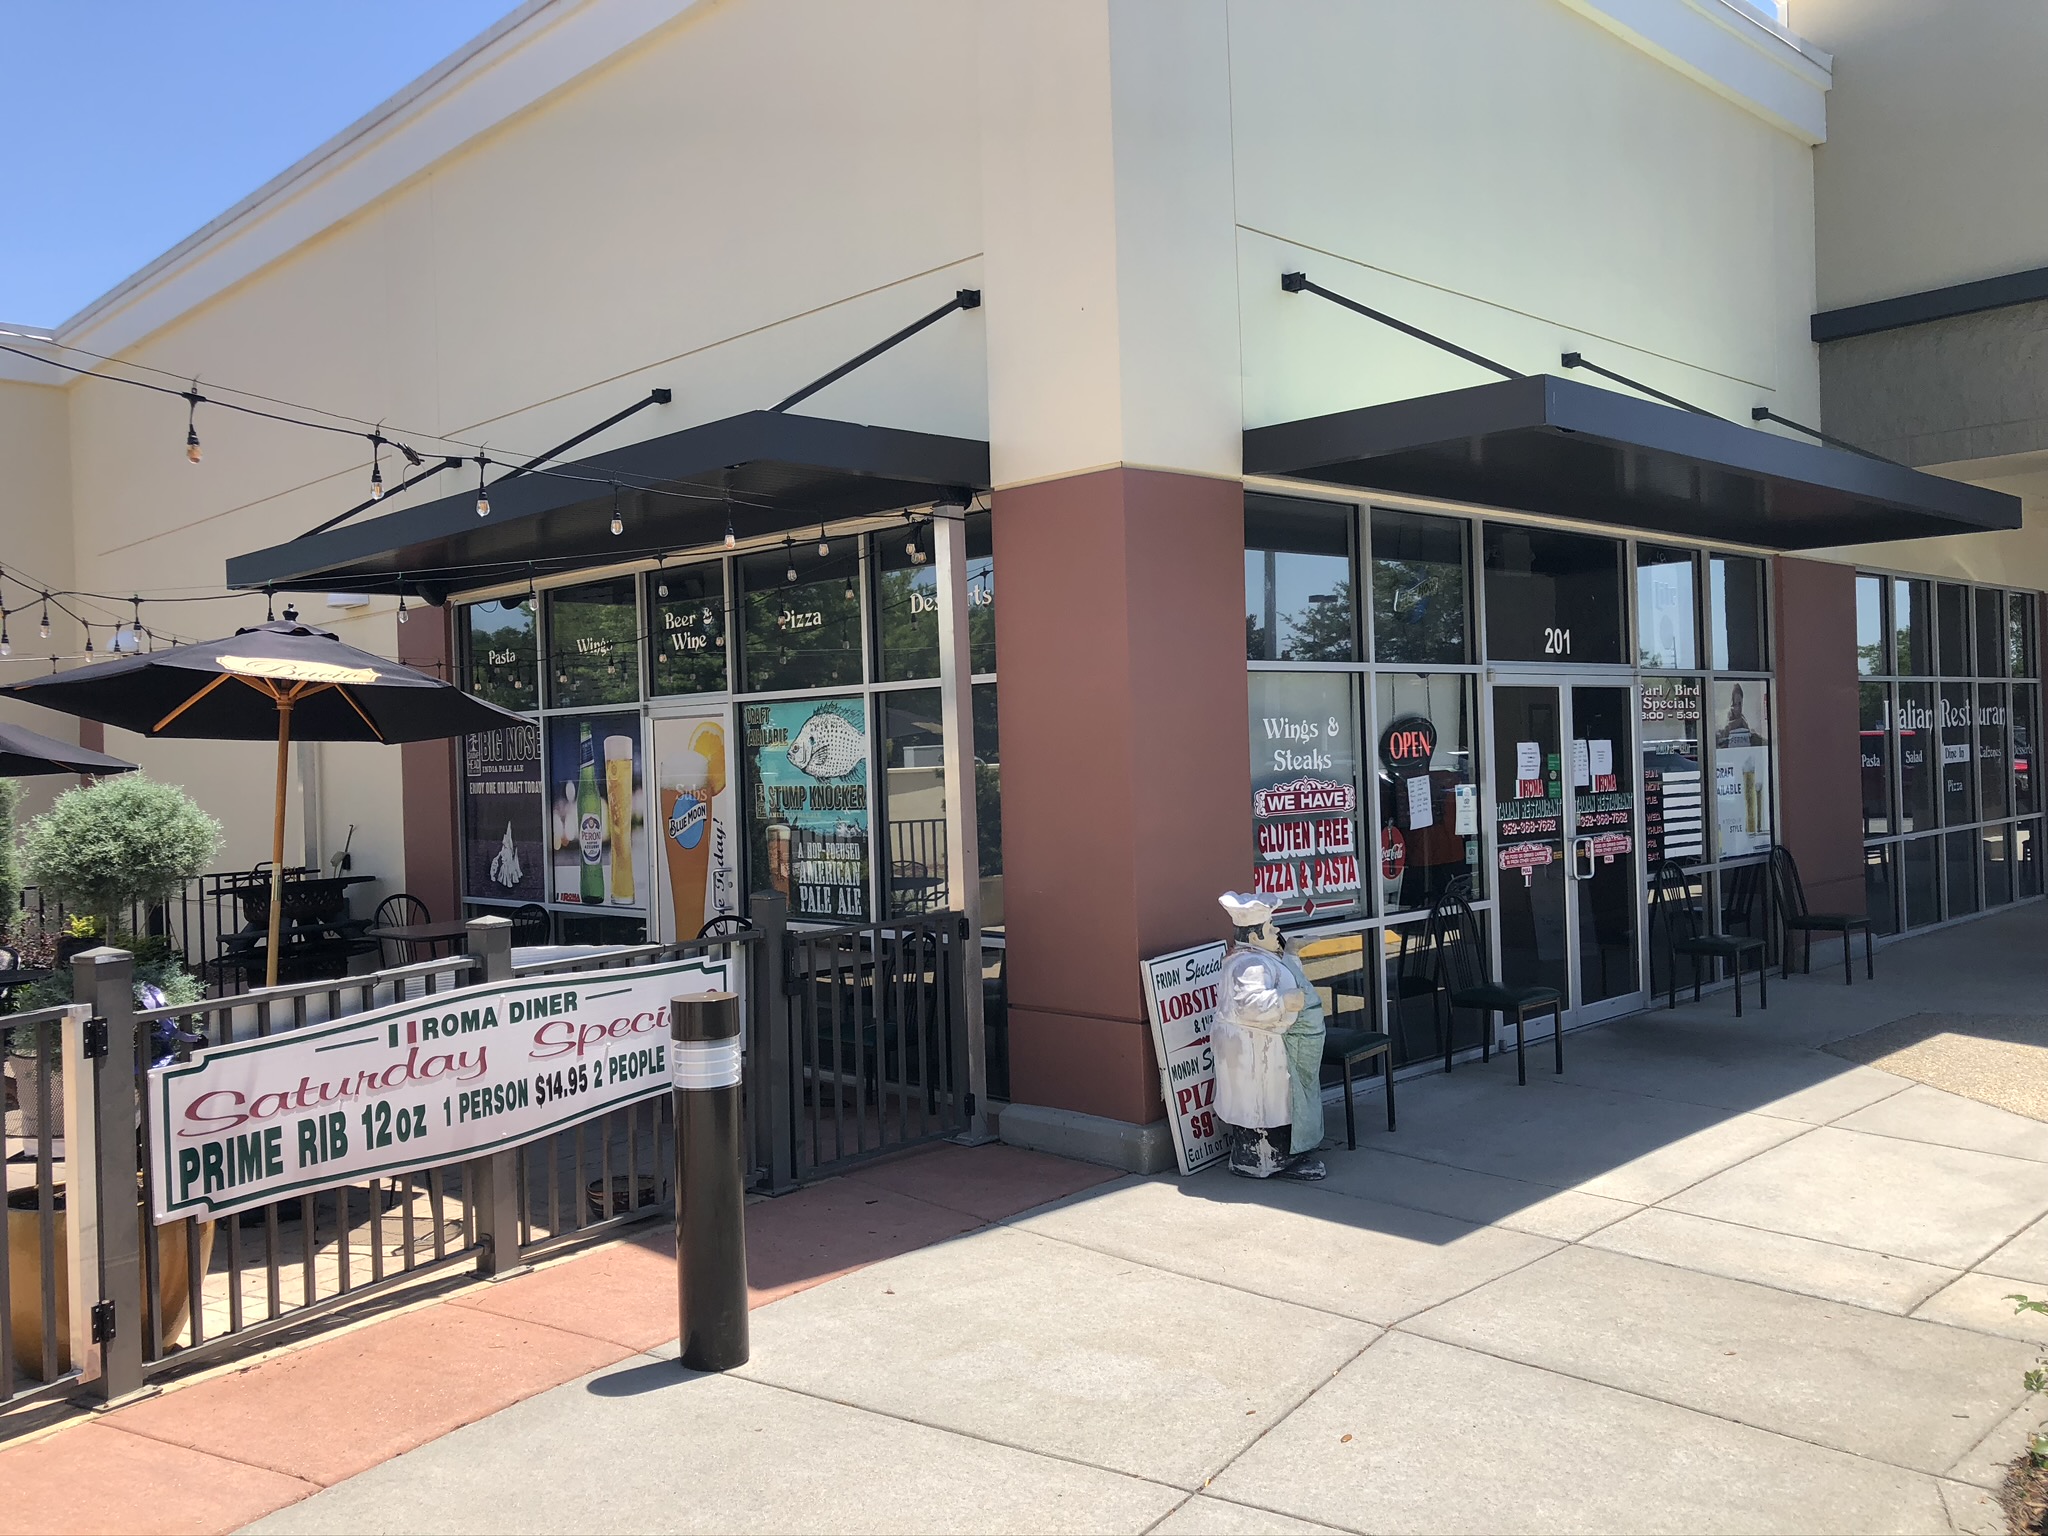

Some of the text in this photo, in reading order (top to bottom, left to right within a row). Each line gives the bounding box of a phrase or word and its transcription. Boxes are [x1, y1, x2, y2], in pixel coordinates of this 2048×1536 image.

[910, 584, 992, 614] Desrts
[665, 607, 713, 630] Beer &
[781, 610, 822, 630] Pizza
[577, 638, 613, 656] Wings
[671, 633, 707, 651] Wine
[1545, 627, 1571, 655] 201
[488, 648, 516, 665] Pasta
[1674, 684, 1700, 696] Bird
[746, 706, 771, 725] DRAFT
[1643, 697, 1696, 711] Specials
[1677, 711, 1700, 719] 5:30
[1884, 698, 2006, 734] Ialian Resturan
[747, 727, 788, 748] AVAILABLE
[1263, 716, 1340, 744] Wings &
[481, 729, 503, 761] BIG
[506, 725, 541, 760] NOSE
[1390, 731, 1431, 759] OPEN
[1945, 747, 1957, 760] Dine
[1273, 748, 1332, 773] Steaks
[1861, 753, 1881, 768] Pasta
[1905, 750, 1923, 763] Salad
[482, 765, 498, 773] INDIA
[499, 764, 512, 773] PALE
[513, 764, 524, 772] ALE
[469, 782, 485, 795] ENJOY
[486, 782, 496, 794] ONE
[497, 781, 505, 794] ON
[506, 781, 523, 794] DRAFT
[1524, 779, 1544, 798] ROMA
[1599, 774, 1617, 792] ROMA
[1716, 783, 1741, 796] AILABLE
[1948, 780, 1963, 792] Pizza
[768, 785, 807, 811] STUMP
[809, 784, 867, 811] KNOCKER
[1267, 791, 1345, 811] WE HAVE
[670, 804, 706, 836] BLUE MOON
[1258, 818, 1353, 859] GLUTEN FREE
[798, 842, 861, 861] A HOP-FOCUSED
[799, 861, 860, 887] AMERICAN
[1254, 855, 1361, 897] PIZZA & PASTA
[800, 886, 862, 916] PALE ALE
[1155, 968, 1181, 991] FRIDAY
[1159, 983, 1219, 1024] LOBSTE
[422, 991, 578, 1041] ROMA DINER
[1194, 1019, 1201, 1033] &
[177, 1004, 673, 1137] Saturday Speci
[1171, 1056, 1200, 1082] MONDAY
[1176, 1078, 1215, 1116] PIZ
[179, 1125, 284, 1202] PRIME
[298, 1111, 348, 1169] RIB
[443, 1096, 451, 1127] 1
[459, 1078, 529, 1124] PERSON
[535, 1063, 588, 1109] $14.95
[593, 1060, 603, 1089] 2
[609, 1045, 665, 1085] PEOPLE
[1188, 1146, 1204, 1163] Eat
[1204, 1142, 1213, 1157] In
[1215, 1139, 1223, 1150] or
